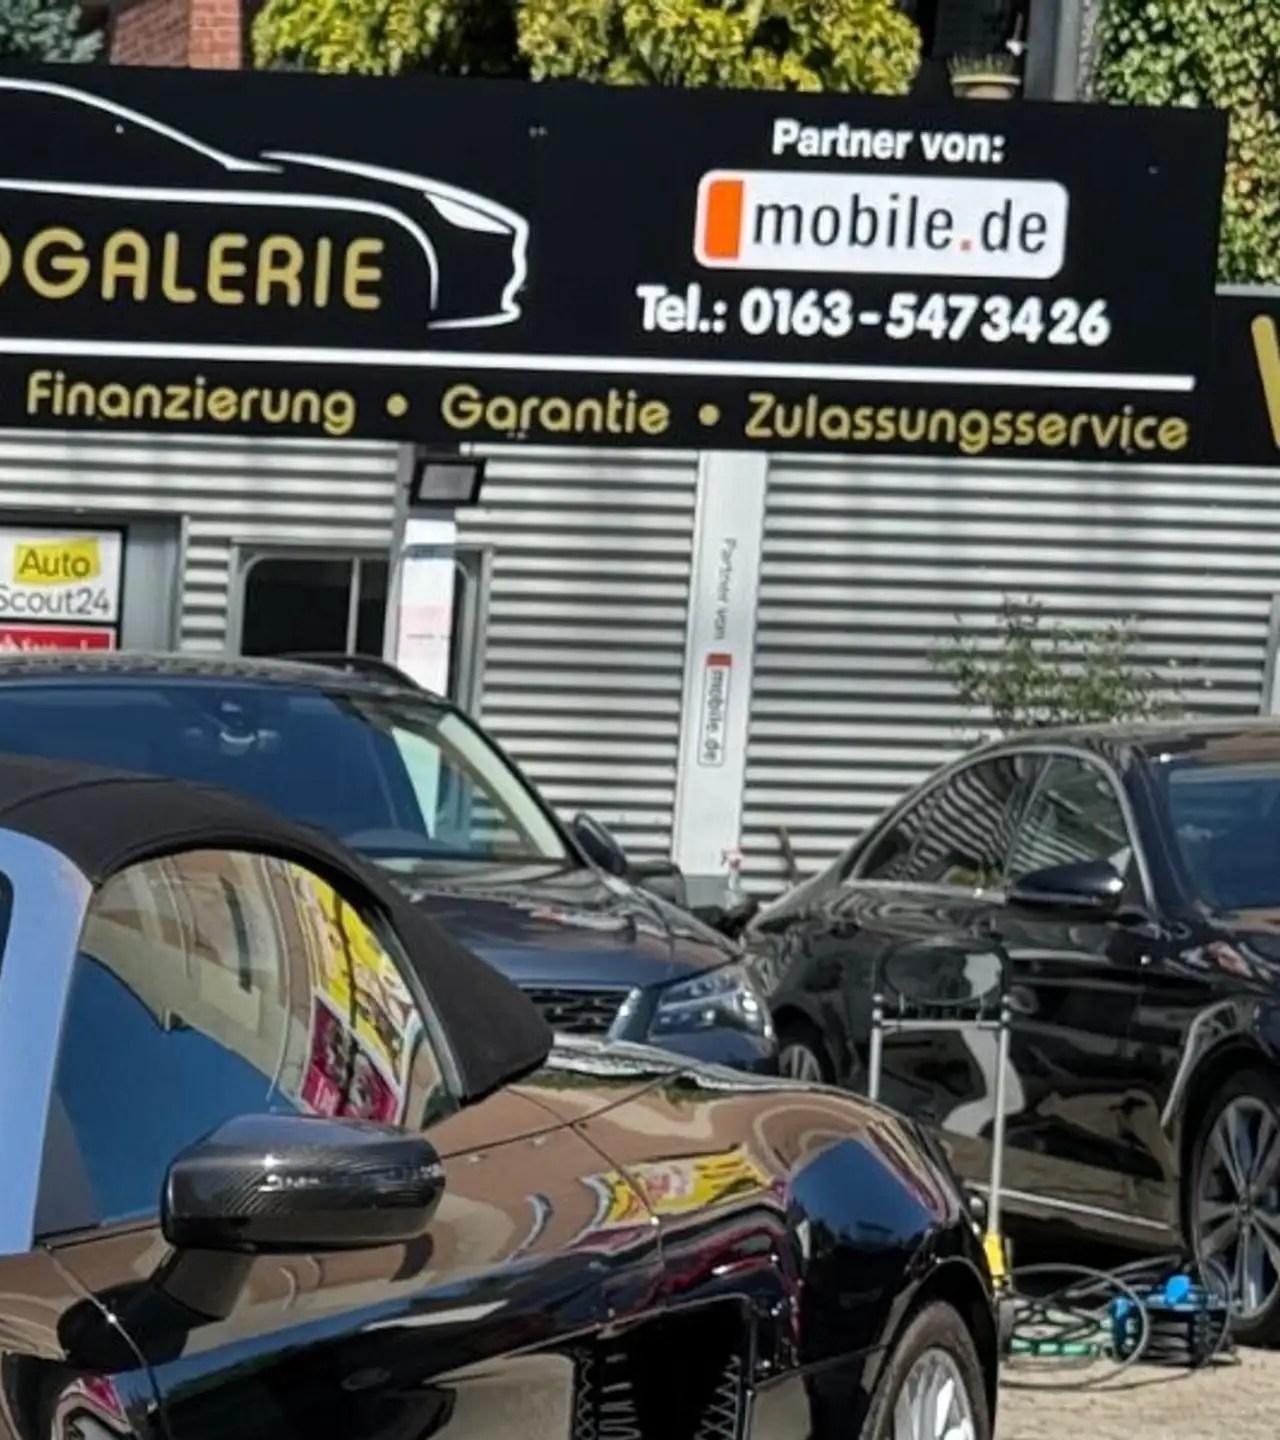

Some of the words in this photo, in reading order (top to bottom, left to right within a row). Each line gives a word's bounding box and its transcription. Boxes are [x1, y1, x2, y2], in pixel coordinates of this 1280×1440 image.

[772, 118, 914, 161] Partner
[920, 131, 1005, 164] von:
[751, 193, 1048, 255] mobile.de
[636, 283, 728, 335] Tel.:
[26, 370, 357, 436] Finanzierung
[441, 383, 670, 437] Garantie
[744, 392, 1190, 454] Zulassungsservice
[18, 549, 92, 578] Auto
[718, 537, 737, 602] Partner
[714, 608, 727, 640] von
[703, 669, 725, 762] mobile.de
